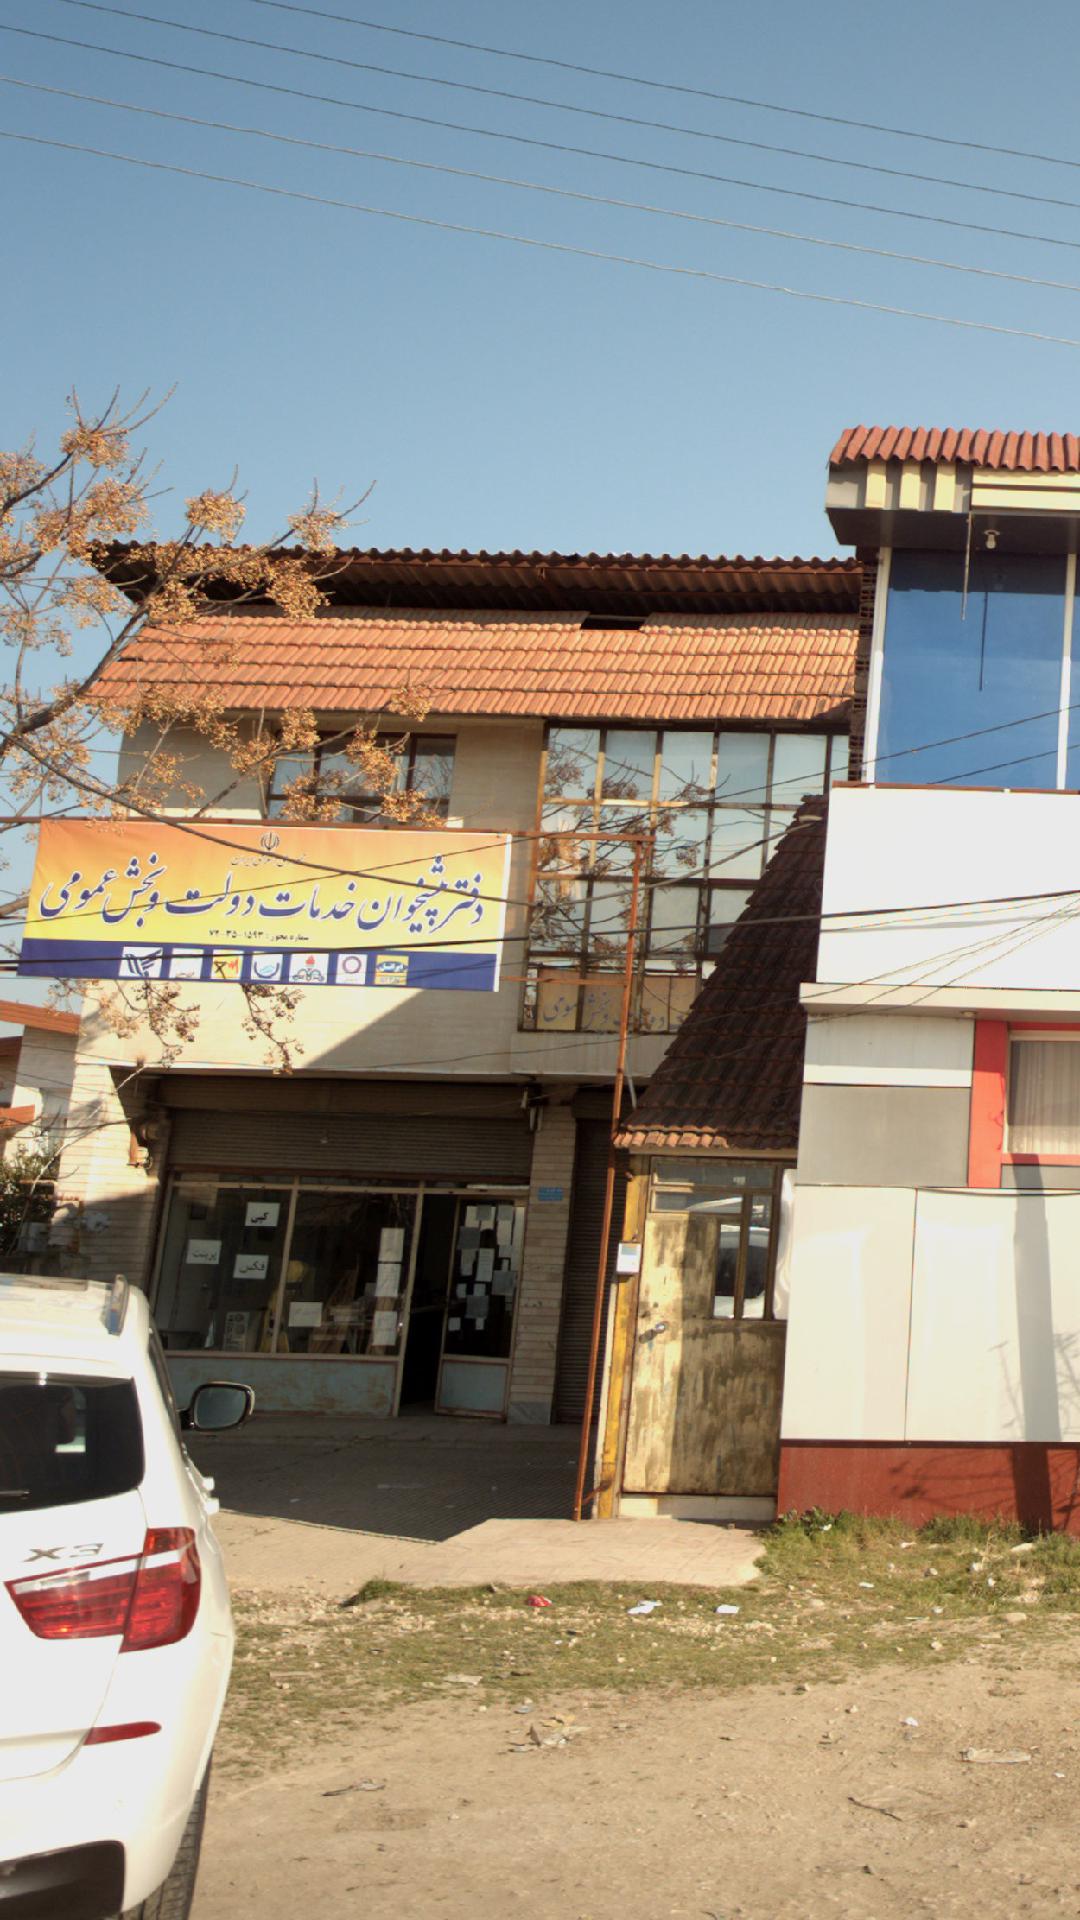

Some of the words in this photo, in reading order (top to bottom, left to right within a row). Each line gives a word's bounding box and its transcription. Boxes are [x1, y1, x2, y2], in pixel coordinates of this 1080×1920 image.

[40, 869, 118, 917] عمومی
[165, 874, 255, 917] دولت
[258, 882, 355, 919] خدمات
[357, 854, 449, 933] پیشخوان
[429, 873, 483, 934] دفتر
[250, 1211, 269, 1224] کپی
[192, 1249, 218, 1261] پرینت
[239, 1260, 265, 1274] فکس
[23, 1542, 104, 1563] X3
